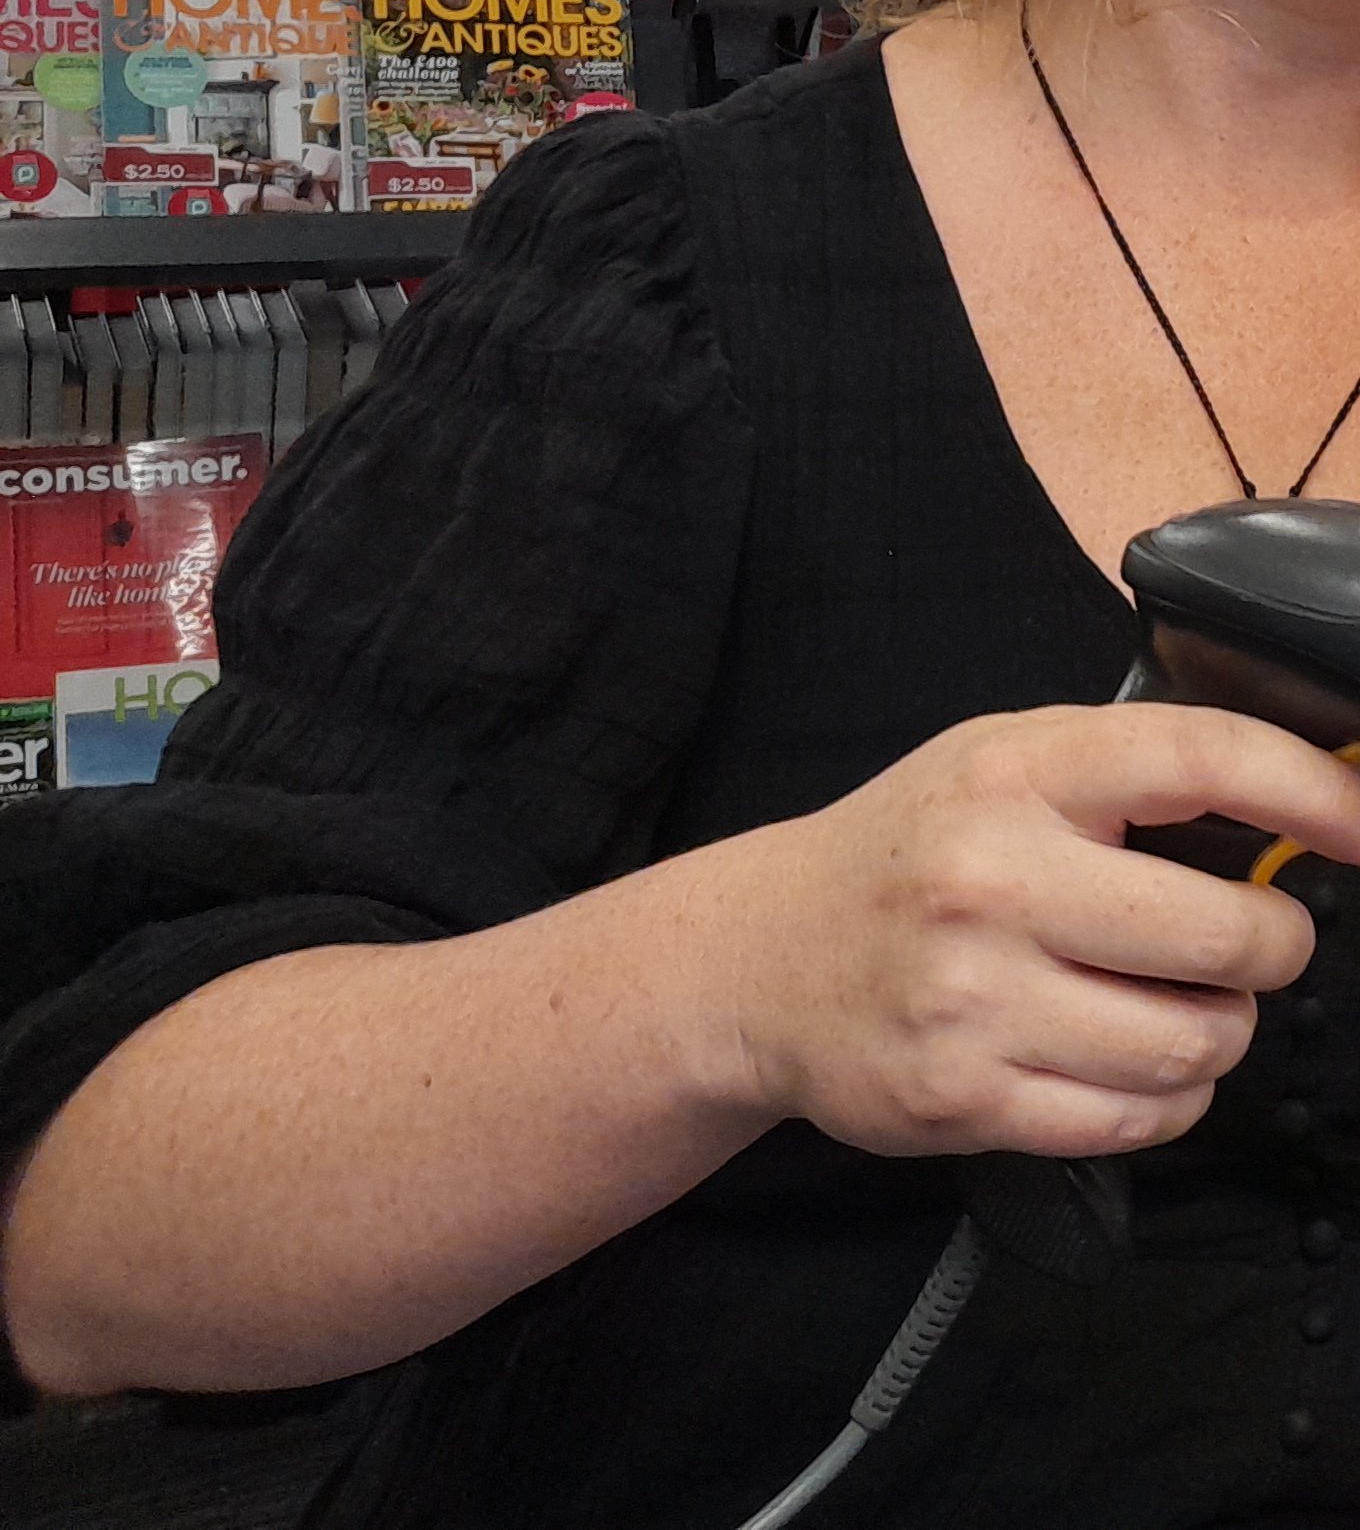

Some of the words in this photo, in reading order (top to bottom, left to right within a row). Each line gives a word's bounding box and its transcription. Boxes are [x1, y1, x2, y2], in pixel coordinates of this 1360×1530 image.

[374, 11, 428, 53] &
[420, 22, 624, 58] ANTIQUES
[378, 54, 412, 69] The
[377, 67, 460, 83] challenge
[123, 163, 186, 180] $2.50
[386, 176, 445, 193] $2.50
[30, 561, 118, 586] There's
[122, 563, 153, 580] no
[67, 585, 108, 610] like
